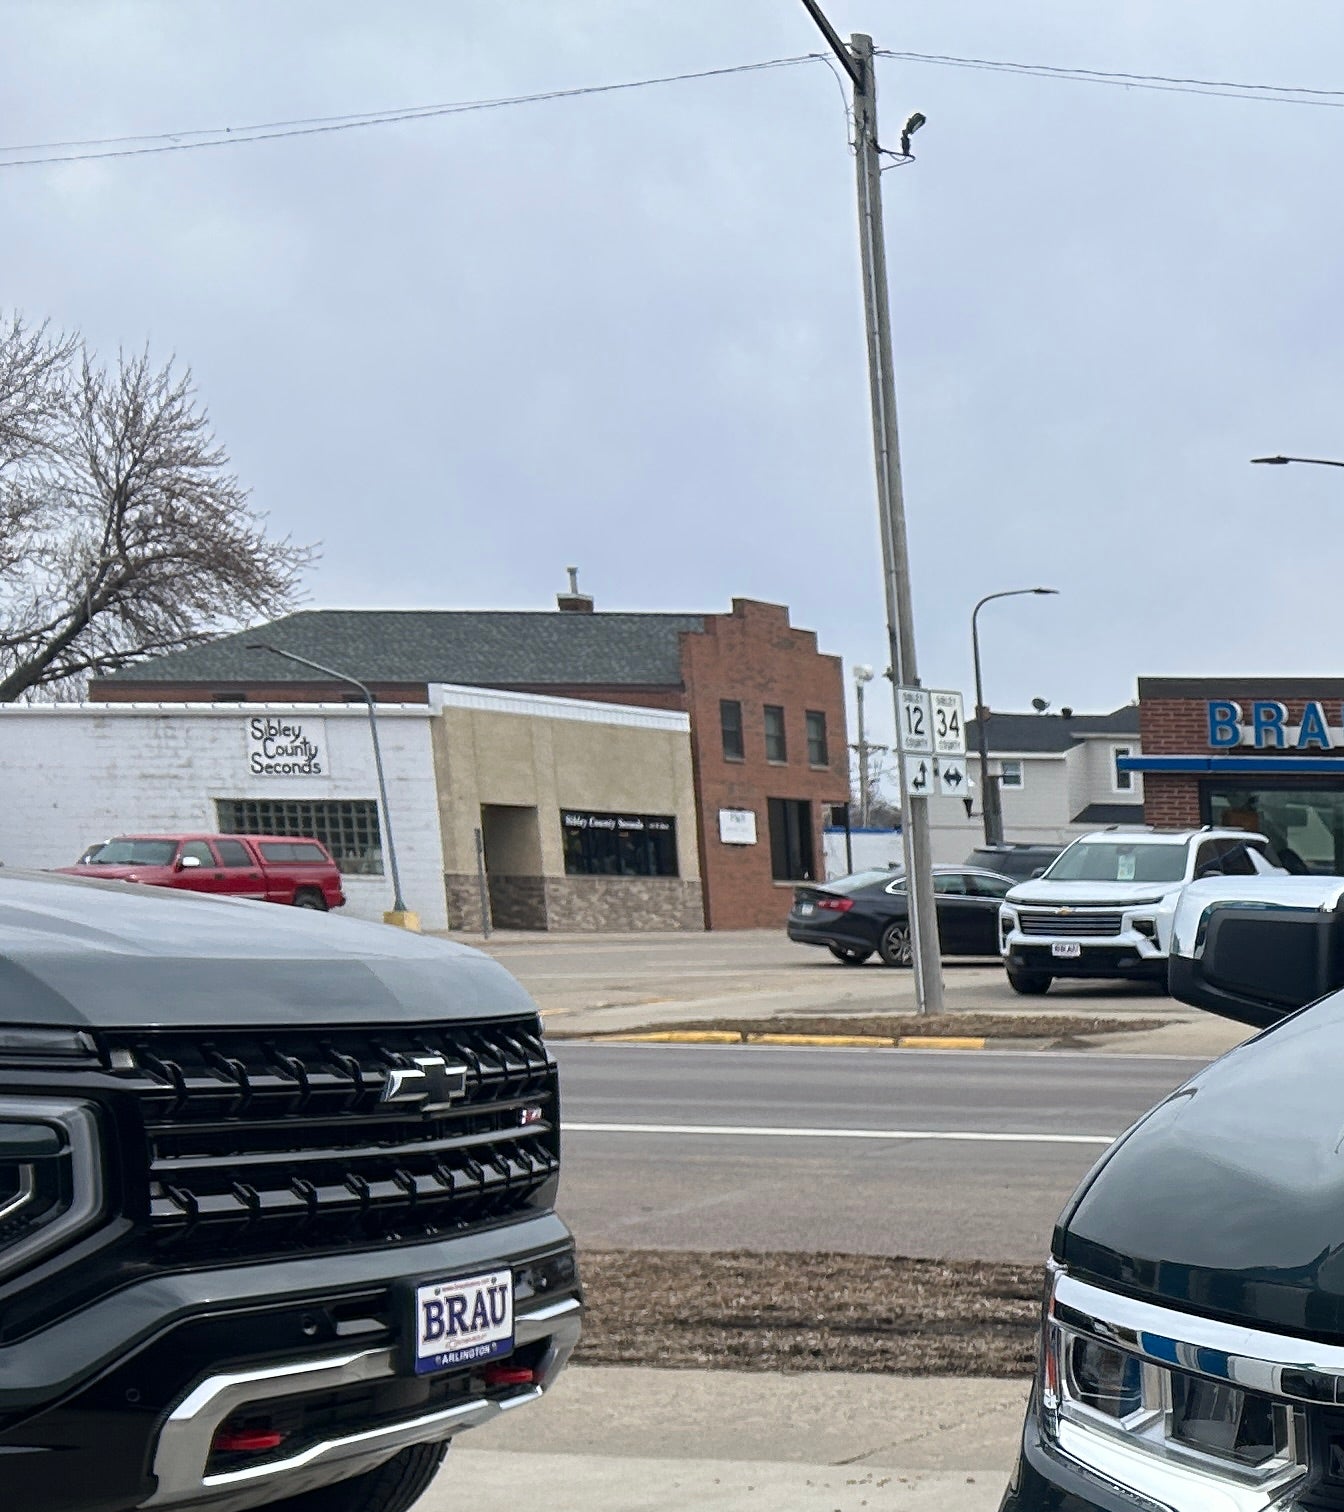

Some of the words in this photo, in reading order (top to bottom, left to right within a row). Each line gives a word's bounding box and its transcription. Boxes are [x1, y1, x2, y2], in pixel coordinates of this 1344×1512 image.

[251, 718, 302, 744] Sibley
[905, 704, 924, 735] 12
[937, 708, 959, 738] 34
[263, 736, 318, 762] County
[250, 751, 322, 774] Seconds
[422, 1284, 508, 1344] BRAU
[441, 1345, 491, 1365] ARLINGTON
